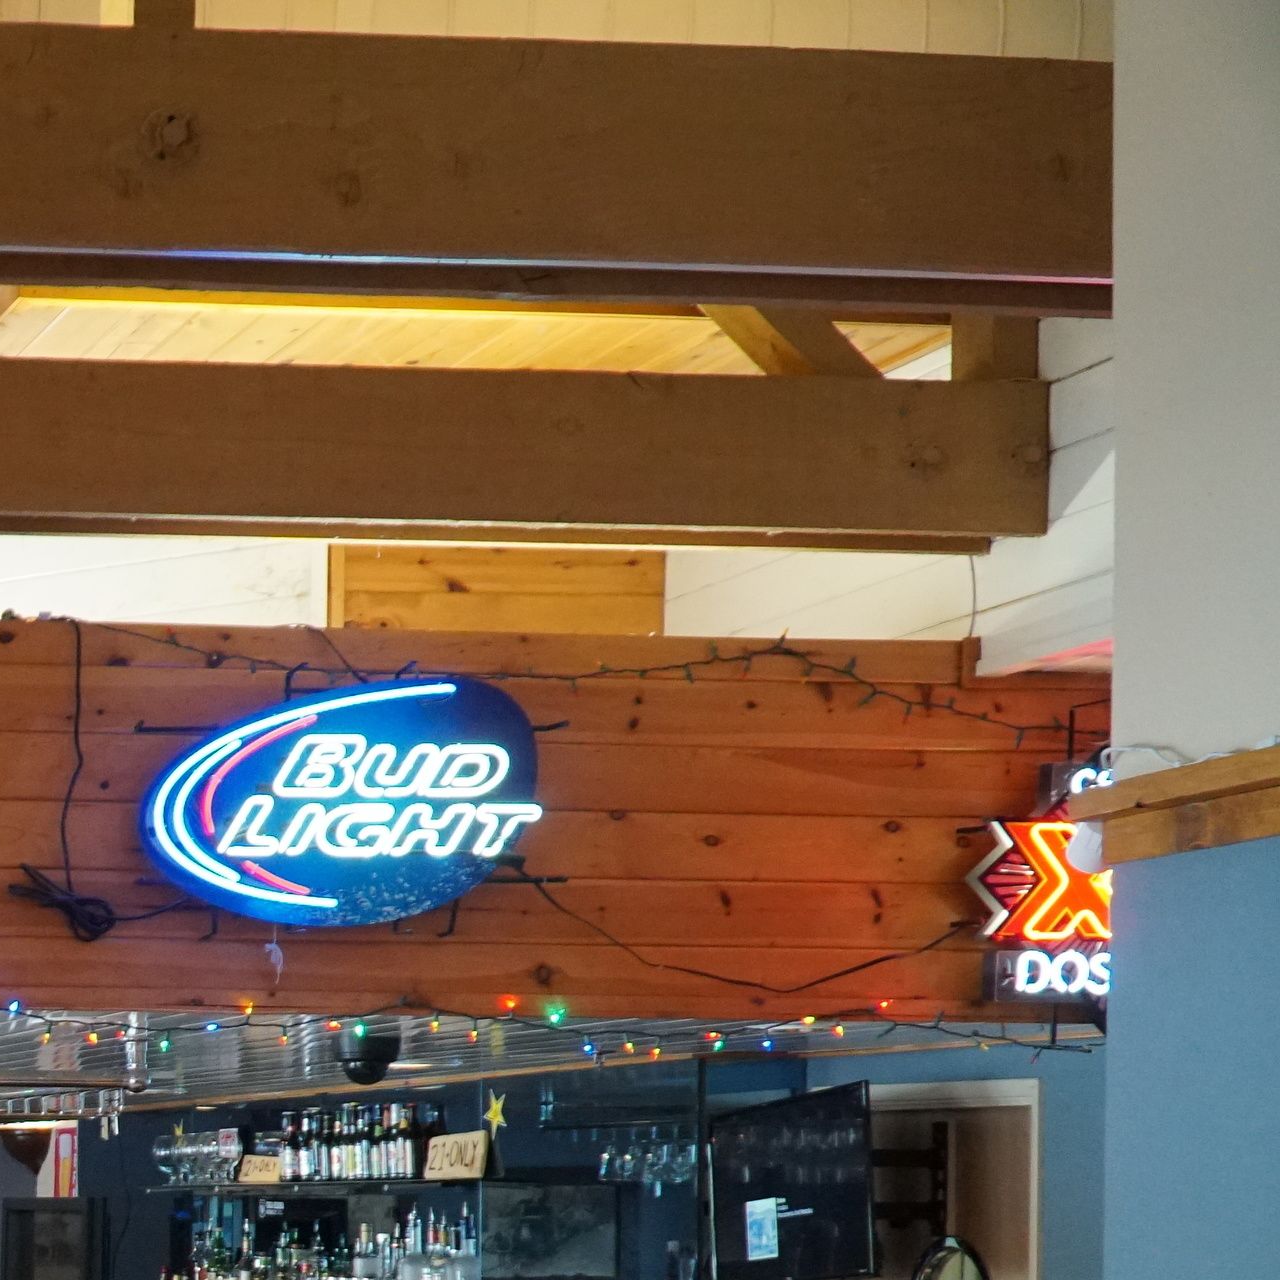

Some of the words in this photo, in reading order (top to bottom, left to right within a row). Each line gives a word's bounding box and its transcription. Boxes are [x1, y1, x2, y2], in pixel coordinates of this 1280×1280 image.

[272, 733, 510, 798] BUD
[217, 794, 542, 858] LIGHT
[1016, 950, 1111, 995] DOS
